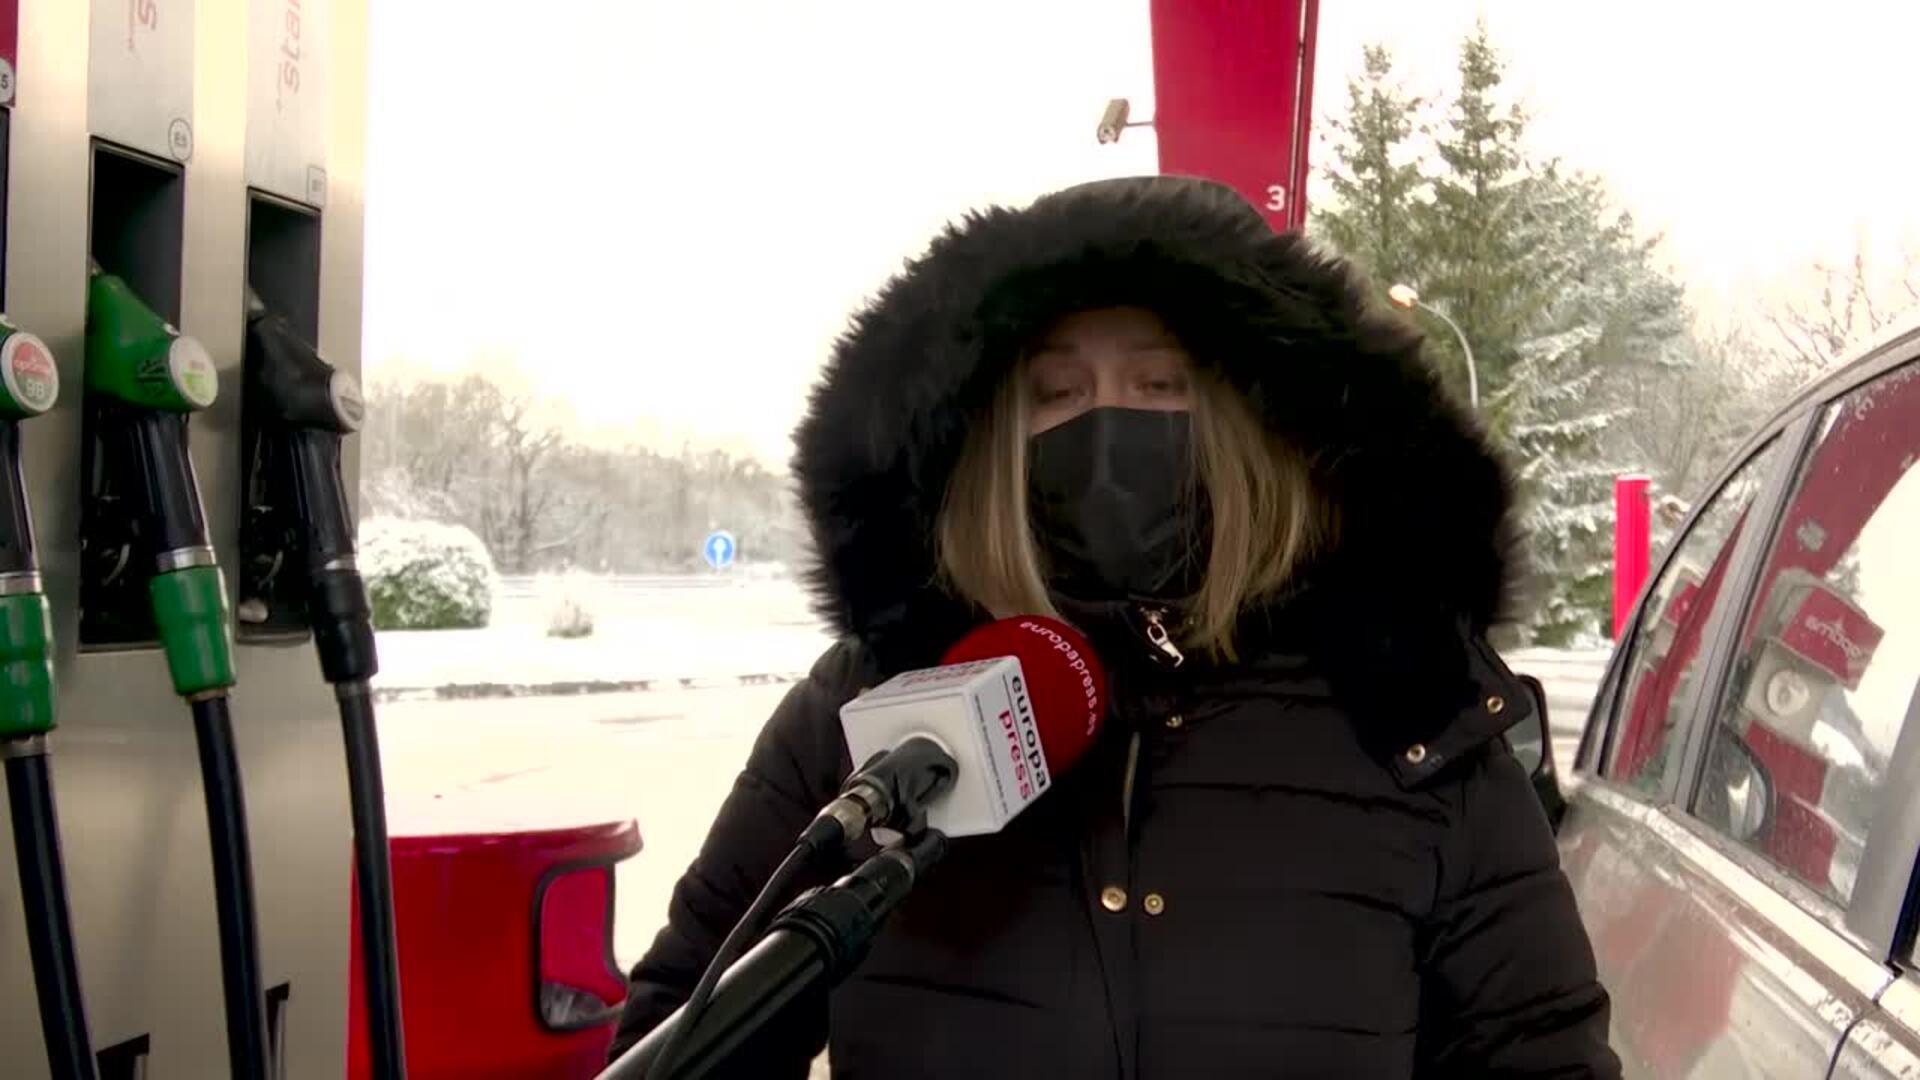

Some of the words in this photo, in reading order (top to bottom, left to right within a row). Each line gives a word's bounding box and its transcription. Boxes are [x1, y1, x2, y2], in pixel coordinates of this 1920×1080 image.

[1266, 185, 1286, 211] 3
[26, 378, 45, 400] 98
[998, 709, 1033, 800] press
[1011, 675, 1047, 789] europa
